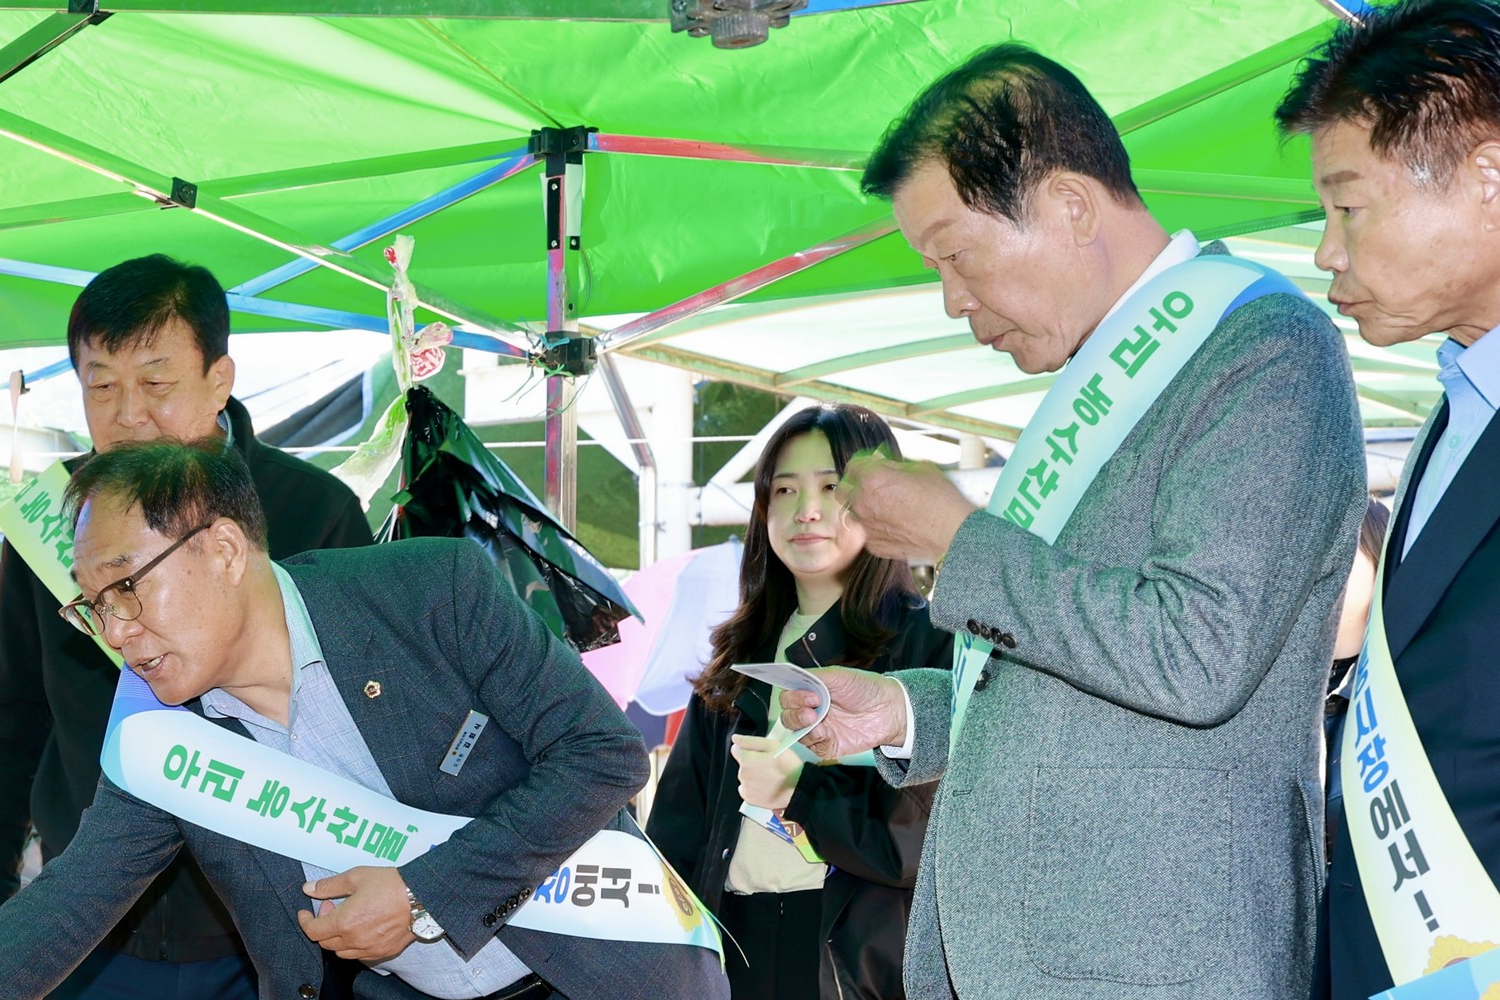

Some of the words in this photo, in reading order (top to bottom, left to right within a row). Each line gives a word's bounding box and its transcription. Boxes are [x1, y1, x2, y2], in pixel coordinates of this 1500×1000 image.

[1109, 290, 1194, 379] 우리
[162, 744, 245, 803] 우리
[246, 779, 419, 863] 농수산물,
